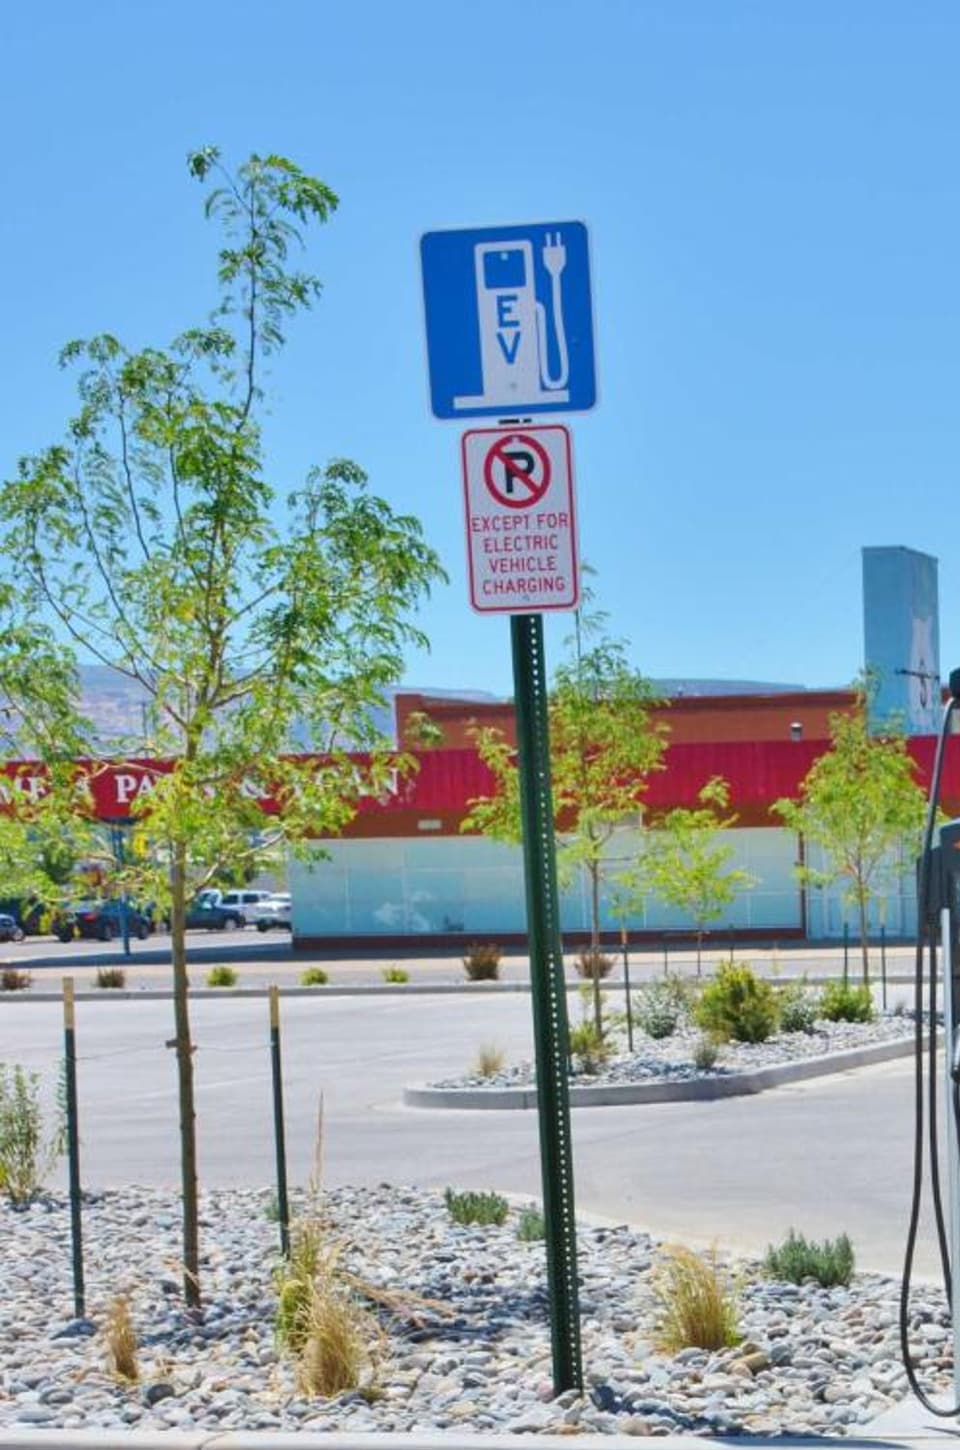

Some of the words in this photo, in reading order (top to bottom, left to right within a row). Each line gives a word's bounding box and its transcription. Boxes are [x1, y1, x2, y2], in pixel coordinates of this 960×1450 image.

[496, 294, 521, 364] EV
[502, 451, 535, 494] P
[472, 514, 530, 533] EXCEPT
[536, 511, 568, 529] FOR
[483, 534, 558, 553] ELECTRIC
[489, 556, 557, 573] VEHICLE
[482, 576, 566, 594] CHARGING
